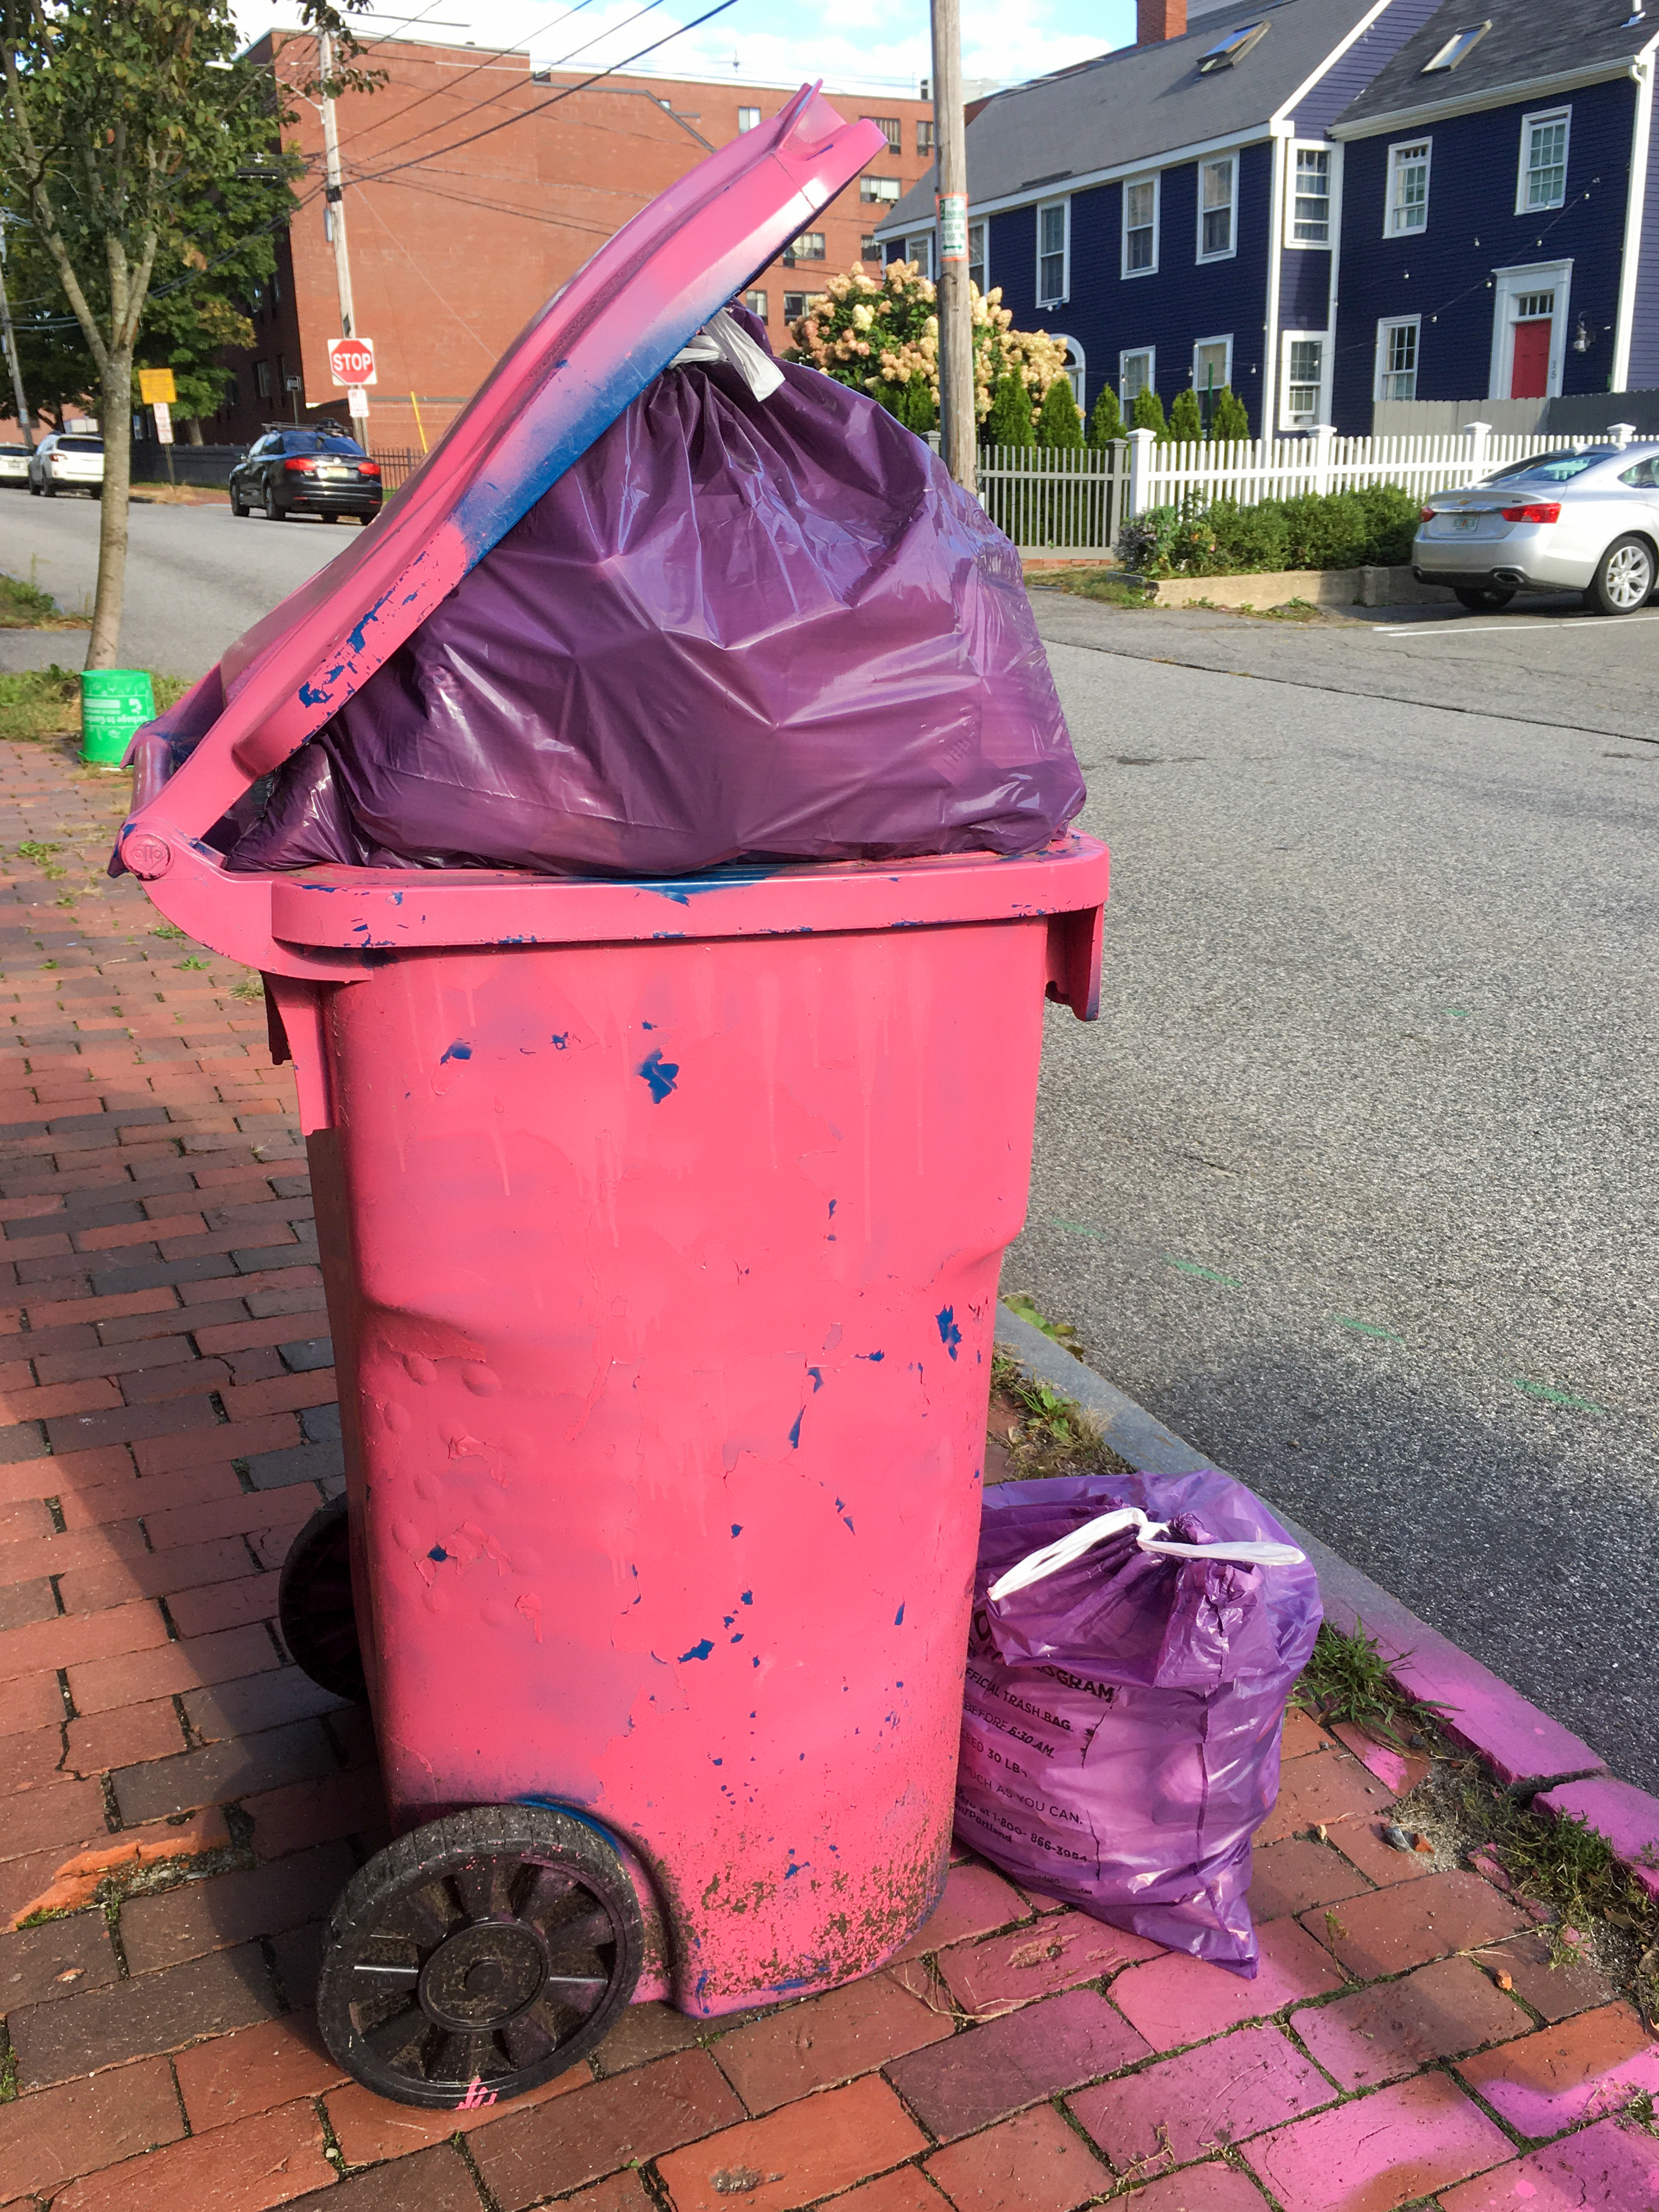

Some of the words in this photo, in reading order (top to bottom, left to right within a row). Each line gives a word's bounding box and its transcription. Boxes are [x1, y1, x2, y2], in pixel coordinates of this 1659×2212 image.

[333, 352, 371, 371] STOP
[107, 715, 116, 725] to
[965, 1666, 999, 1698] FFICIAL
[1004, 1690, 1041, 1719] TRASH
[1043, 1712, 1074, 1732] BAG.
[1033, 1665, 1115, 1703] OGRAM
[961, 1728, 984, 1752] CEED
[987, 1747, 1002, 1764] 30
[963, 1700, 1008, 1731] BEFORE
[1008, 1726, 1034, 1745] 6:30
[1032, 1737, 1055, 1759] AM.
[980, 1808, 990, 1817] at
[996, 1785, 1012, 1798] AS
[1016, 1794, 1045, 1812] YOU
[1049, 1805, 1083, 1825] CAN.
